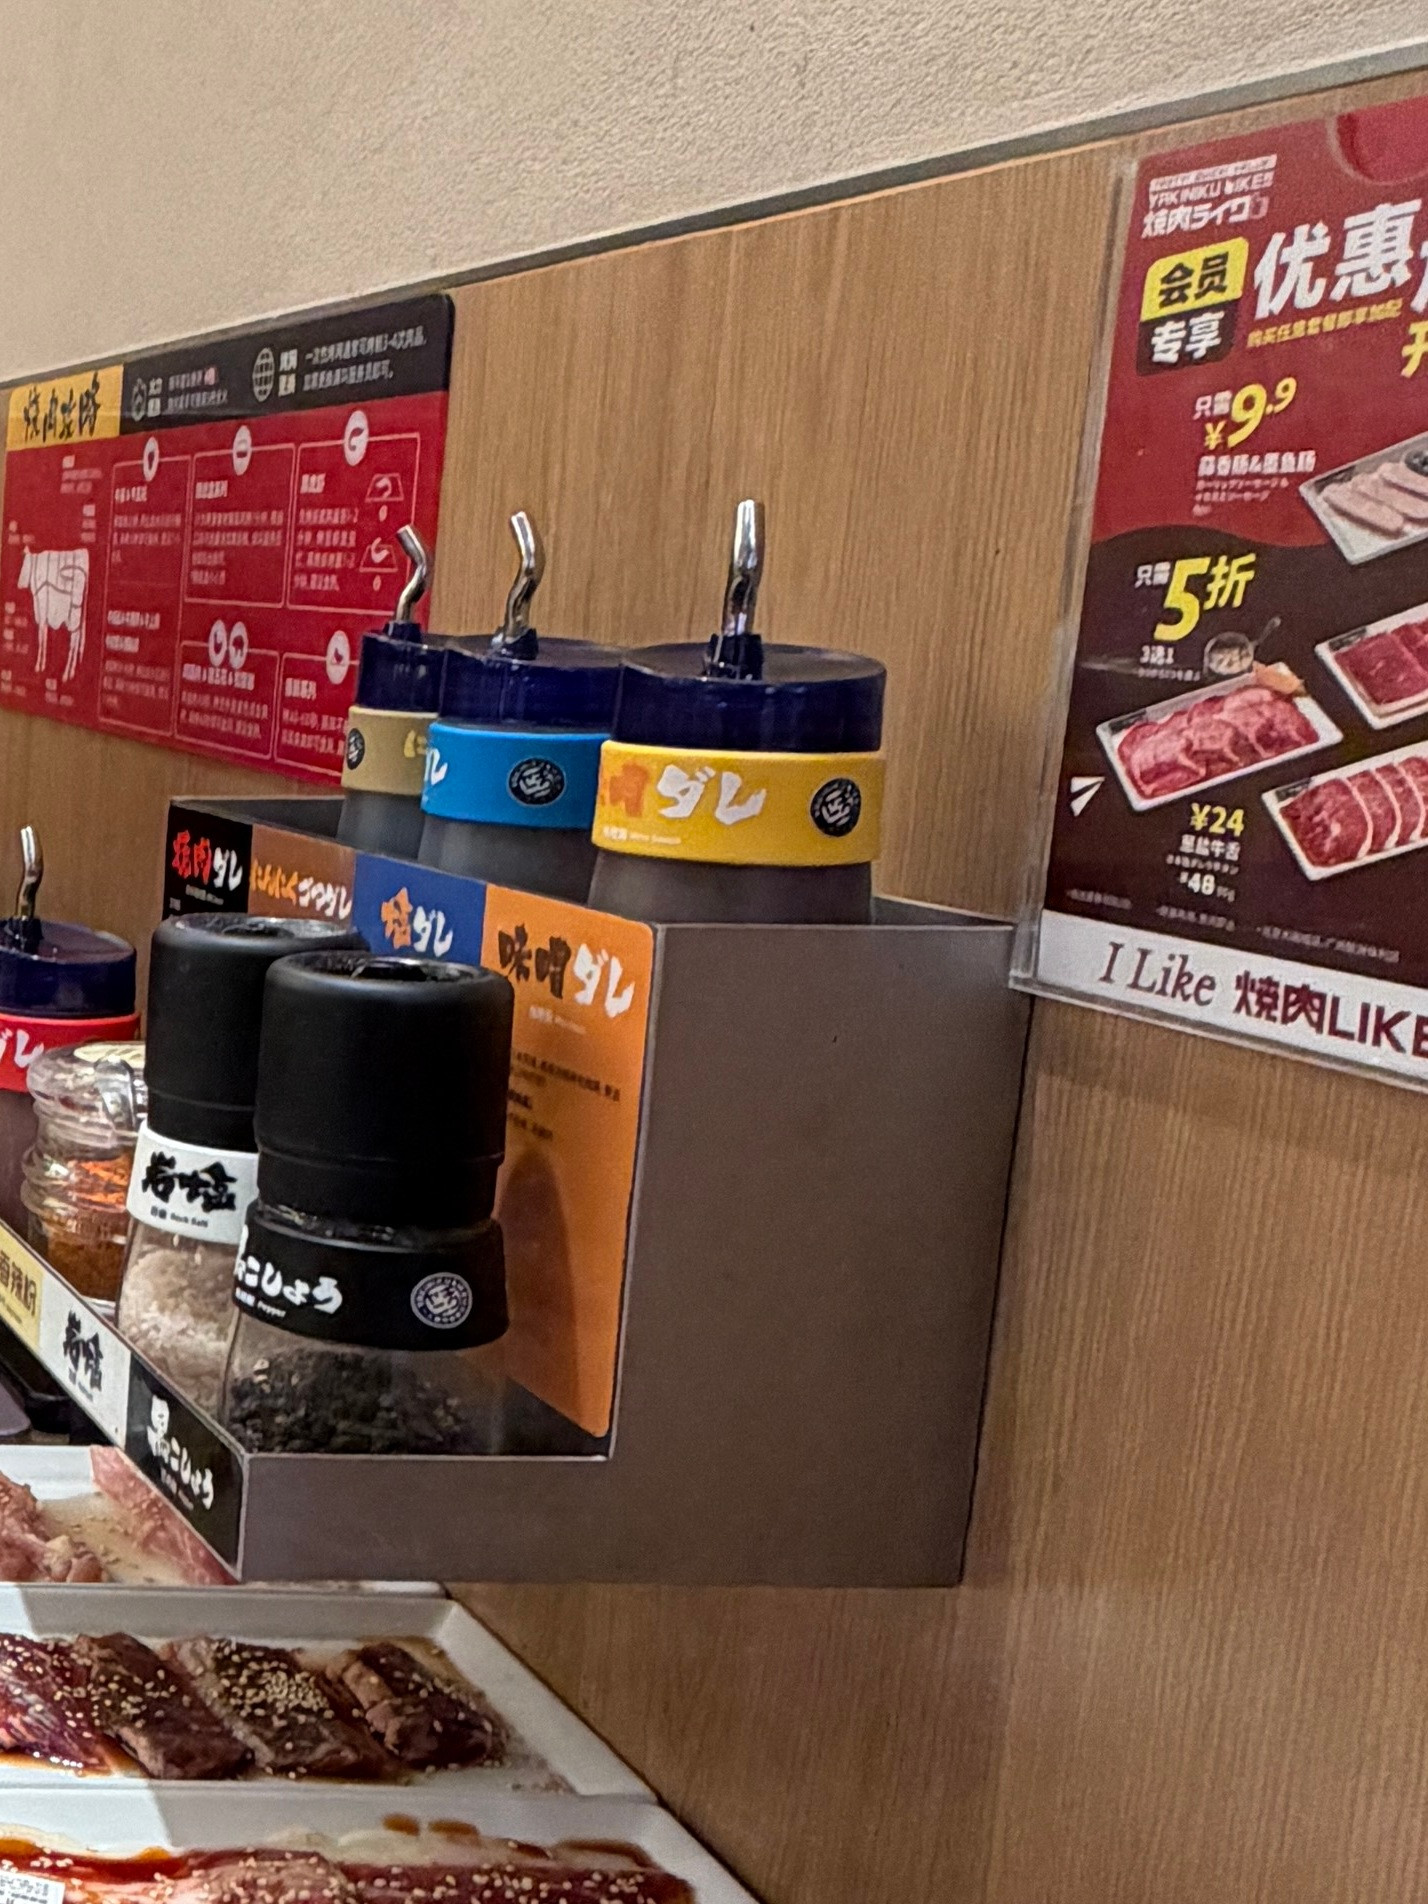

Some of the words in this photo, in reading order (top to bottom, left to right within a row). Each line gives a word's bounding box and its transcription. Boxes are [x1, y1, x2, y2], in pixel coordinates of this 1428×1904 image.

[1158, 251, 1231, 307] 会员
[1150, 310, 1227, 365] 专享
[1193, 389, 1232, 419] 只需
[1134, 562, 1172, 588] 只需
[1189, 802, 1245, 838] ¥24
[1098, 941, 1125, 984] I
[1127, 947, 1217, 1007] Like
